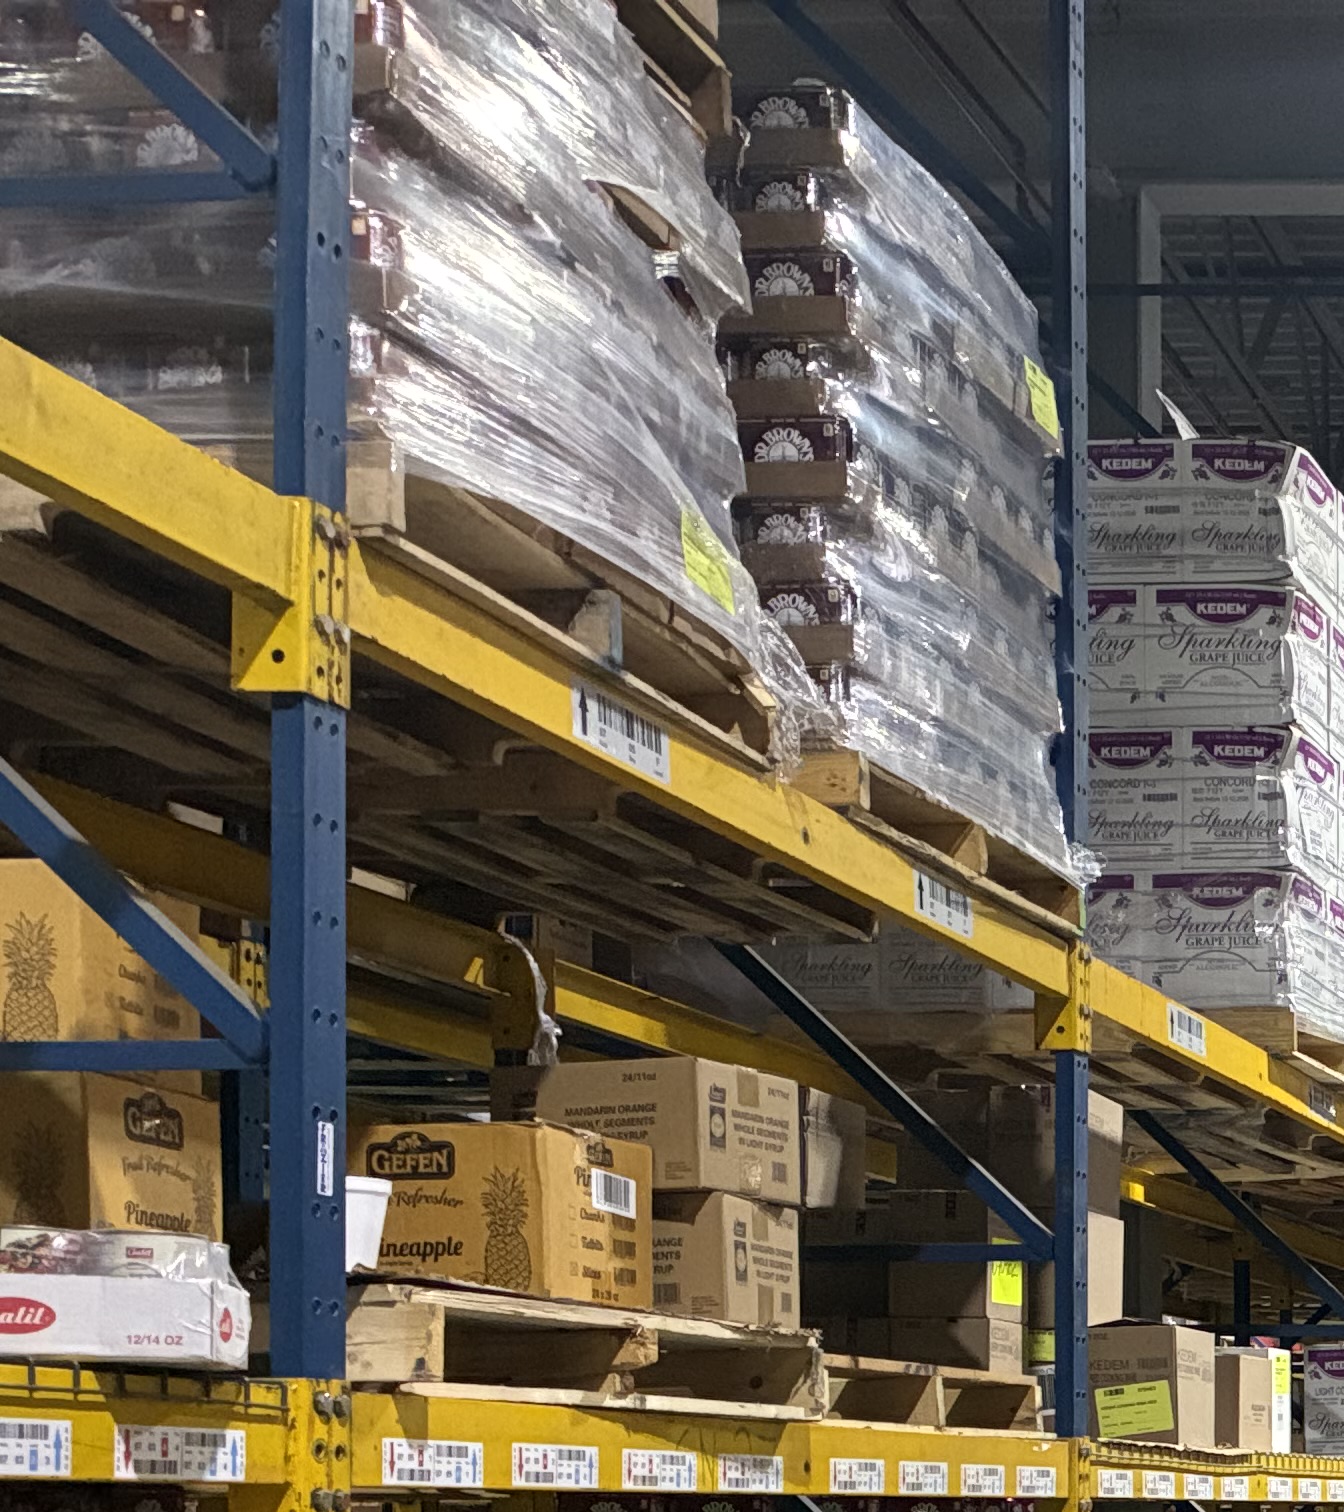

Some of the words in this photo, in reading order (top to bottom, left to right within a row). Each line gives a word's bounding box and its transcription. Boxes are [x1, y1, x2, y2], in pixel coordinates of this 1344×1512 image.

[1102, 458, 1152, 471] KEDEM
[1214, 458, 1265, 472] KEDEM
[1191, 520, 1281, 549] Sparkling
[1197, 603, 1247, 615] KEDEM
[1157, 623, 1284, 659] Sparkling
[1189, 653, 1229, 663] GRAPE
[1232, 652, 1265, 668] JUICE
[1100, 746, 1151, 757] KEDEM
[1214, 744, 1265, 757] KEDEM
[1089, 808, 1174, 836] Sparkling
[1192, 886, 1244, 898] KEDEM
[1186, 936, 1225, 946] GRAPE
[1228, 935, 1262, 949] JUICE
[565, 1106, 616, 1117] MANDARIN
[618, 1103, 657, 1114] ORANGE
[604, 1117, 655, 1128] SEGMENTS
[372, 1149, 449, 1174] GEFEN
[395, 1188, 464, 1209] Refresher
[124, 1200, 192, 1232] Pineapple
[379, 1237, 464, 1263] ineapple
[127, 1334, 160, 1346] 12/14
[164, 1335, 183, 1346] OZ
[1088, 1359, 1129, 1371] KEDEM
